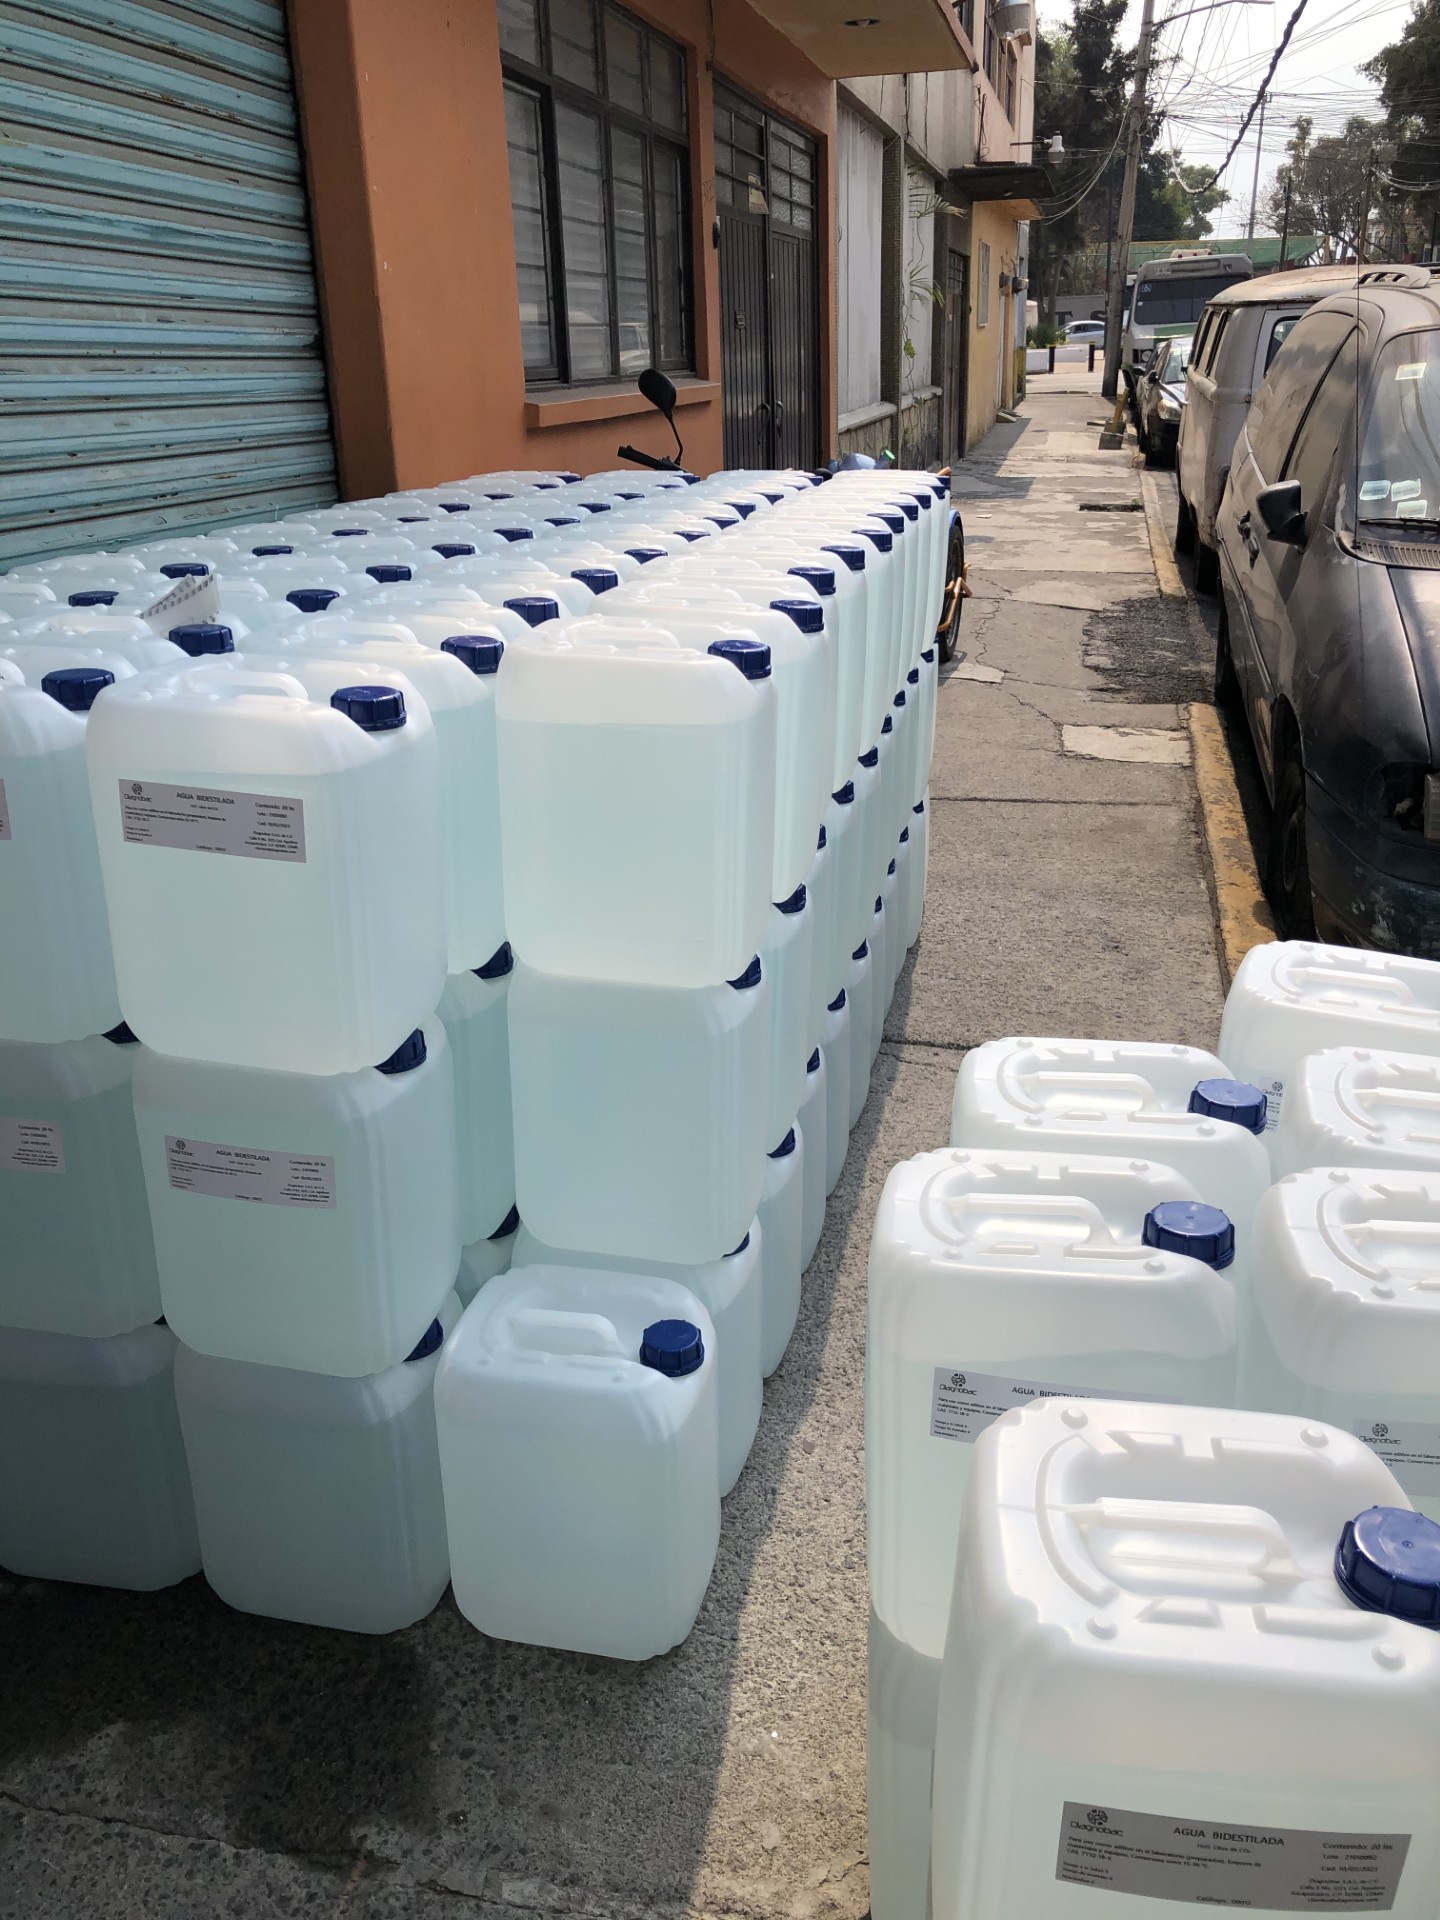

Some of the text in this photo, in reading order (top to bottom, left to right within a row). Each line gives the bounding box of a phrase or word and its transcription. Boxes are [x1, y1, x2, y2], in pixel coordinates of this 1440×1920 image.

[176, 792, 236, 804] AGUA BIDESTILADA
[216, 1149, 271, 1162] AGUA BIDESTILADA
[939, 1383, 978, 1396] Diagnobac
[1012, 1386, 1035, 1396] AGUA
[1359, 1435, 1401, 1445] Diagnobac
[1070, 1820, 1124, 1838] Diagnobac
[1173, 1826, 1206, 1839] AGUA
[1212, 1831, 1285, 1847] BIDESTILADA
